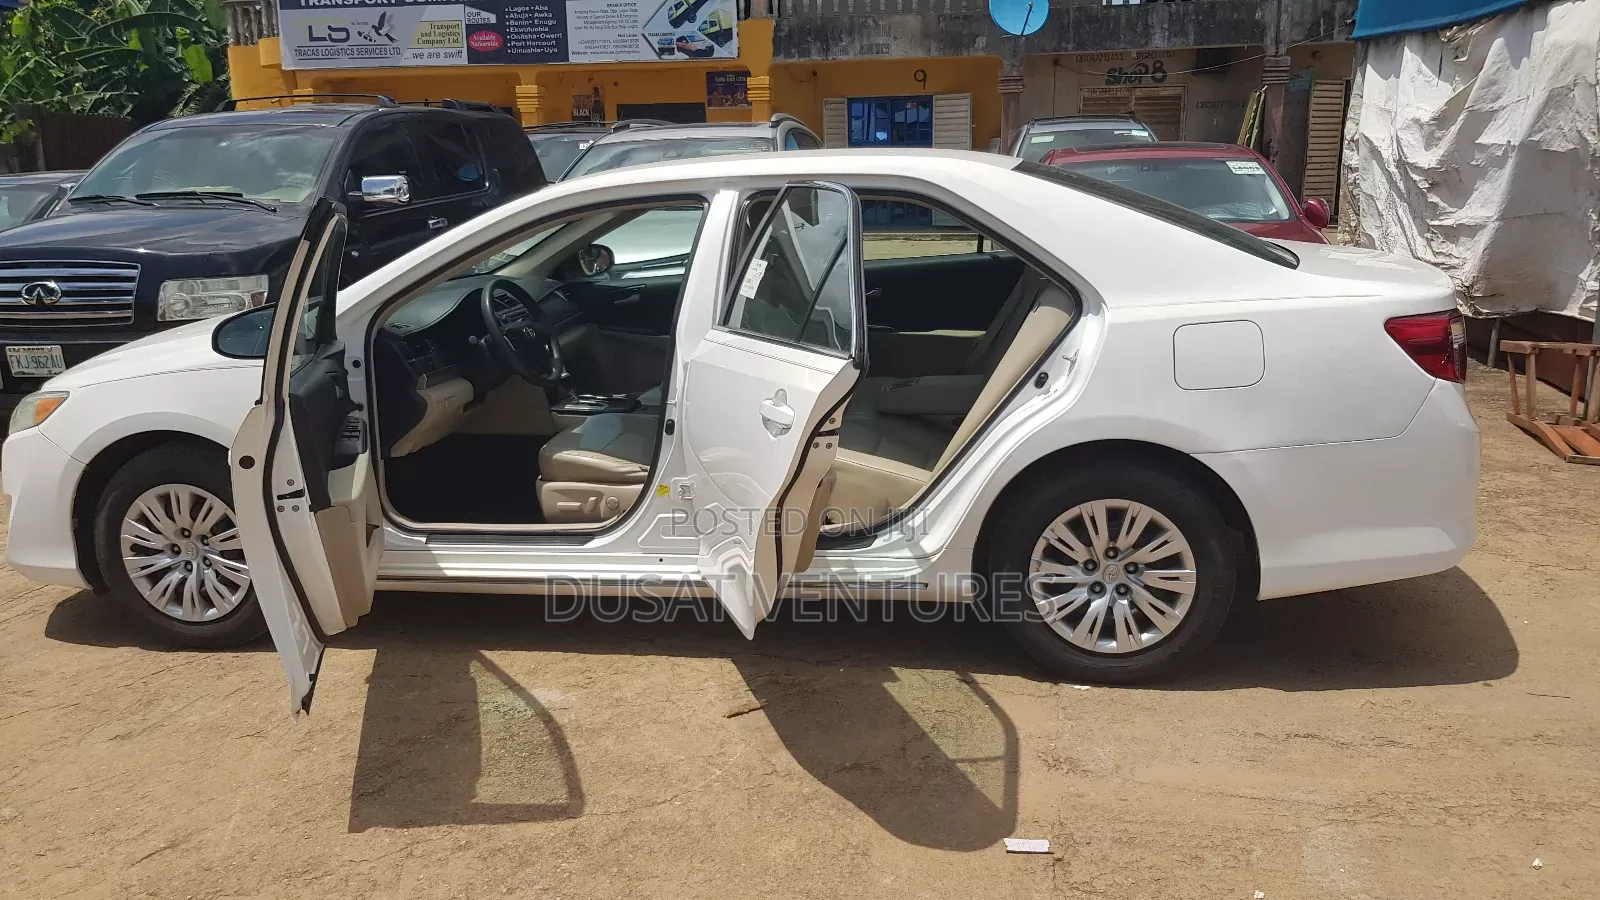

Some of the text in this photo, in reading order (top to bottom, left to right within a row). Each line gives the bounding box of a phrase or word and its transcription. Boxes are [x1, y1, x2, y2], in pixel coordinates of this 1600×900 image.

[434, 30, 461, 38] Logistics
[417, 38, 446, 46] Company
[294, 47, 403, 57] TRACAS LOGISTICS SERVICES LTD.
[444, 50, 463, 58] swift
[1151, 59, 1168, 83] 8
[914, 69, 927, 90] 9
